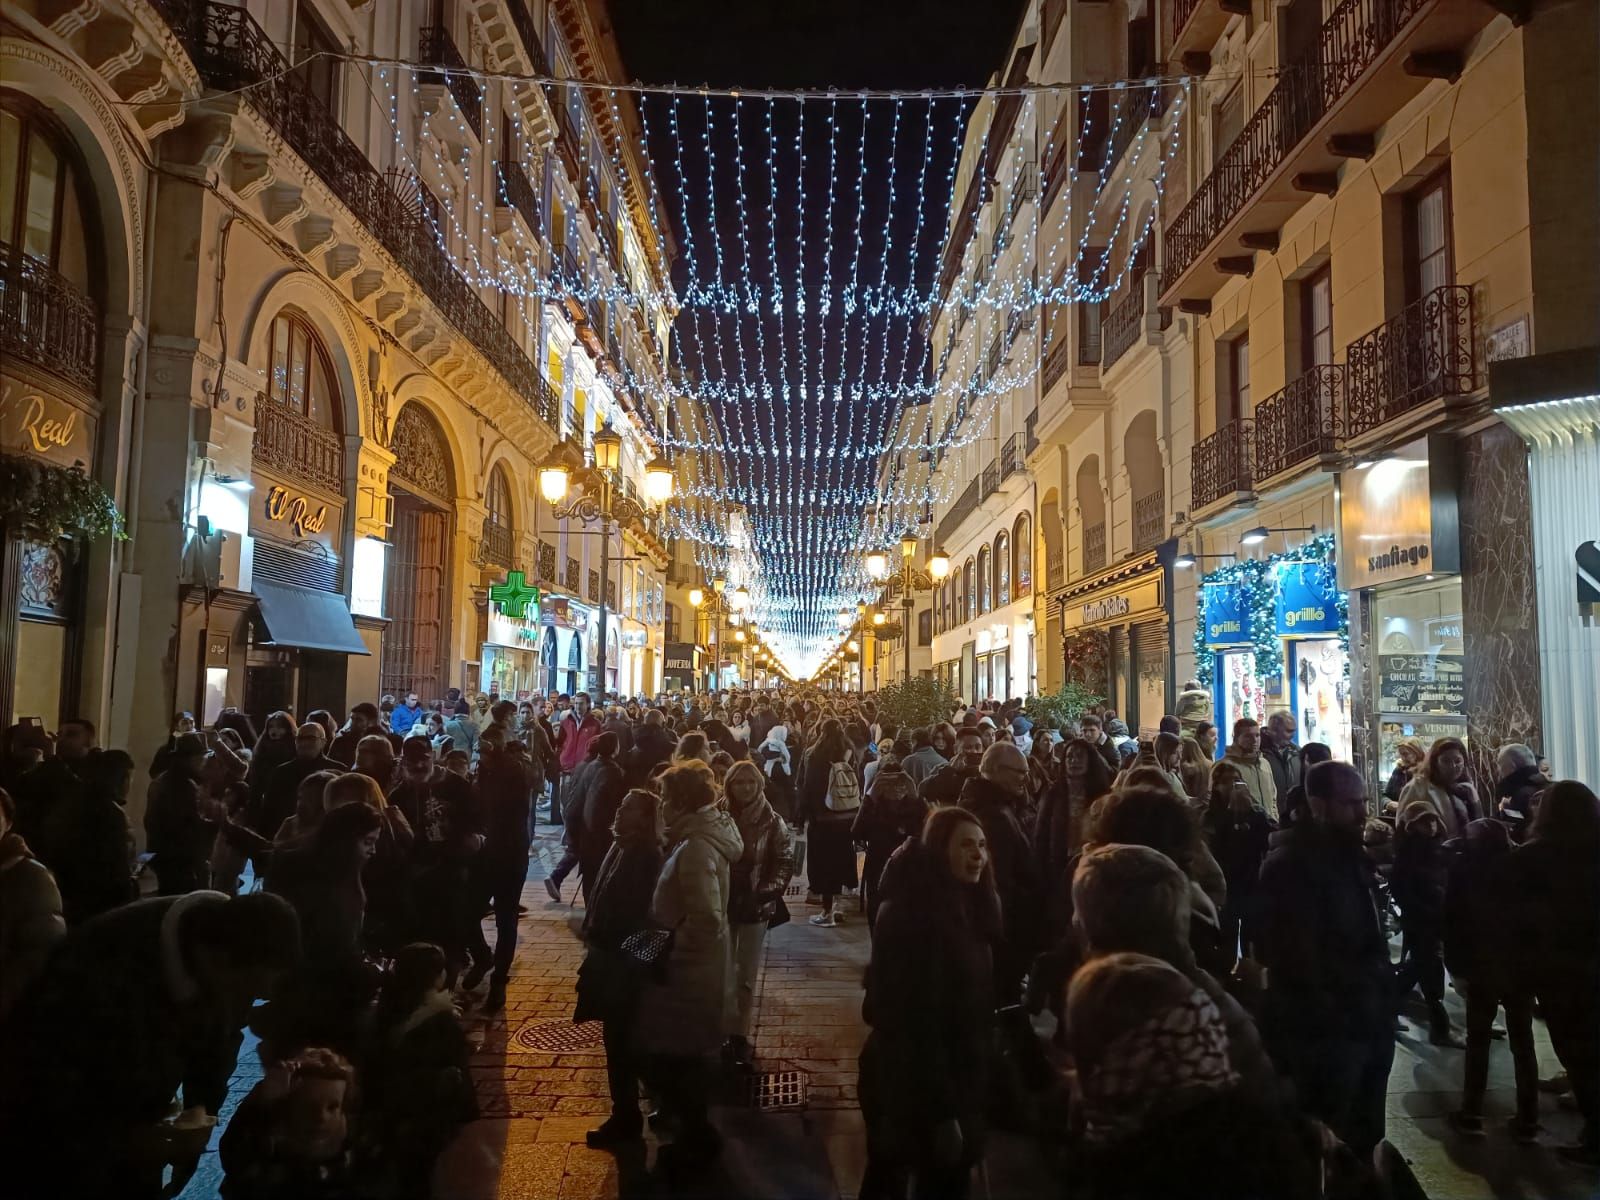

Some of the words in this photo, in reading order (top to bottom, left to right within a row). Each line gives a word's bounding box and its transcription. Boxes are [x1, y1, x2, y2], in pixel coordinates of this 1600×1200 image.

[15, 395, 77, 453] Real
[267, 486, 289, 520] El
[289, 497, 327, 538] Real
[1368, 545, 1429, 572] santiago
